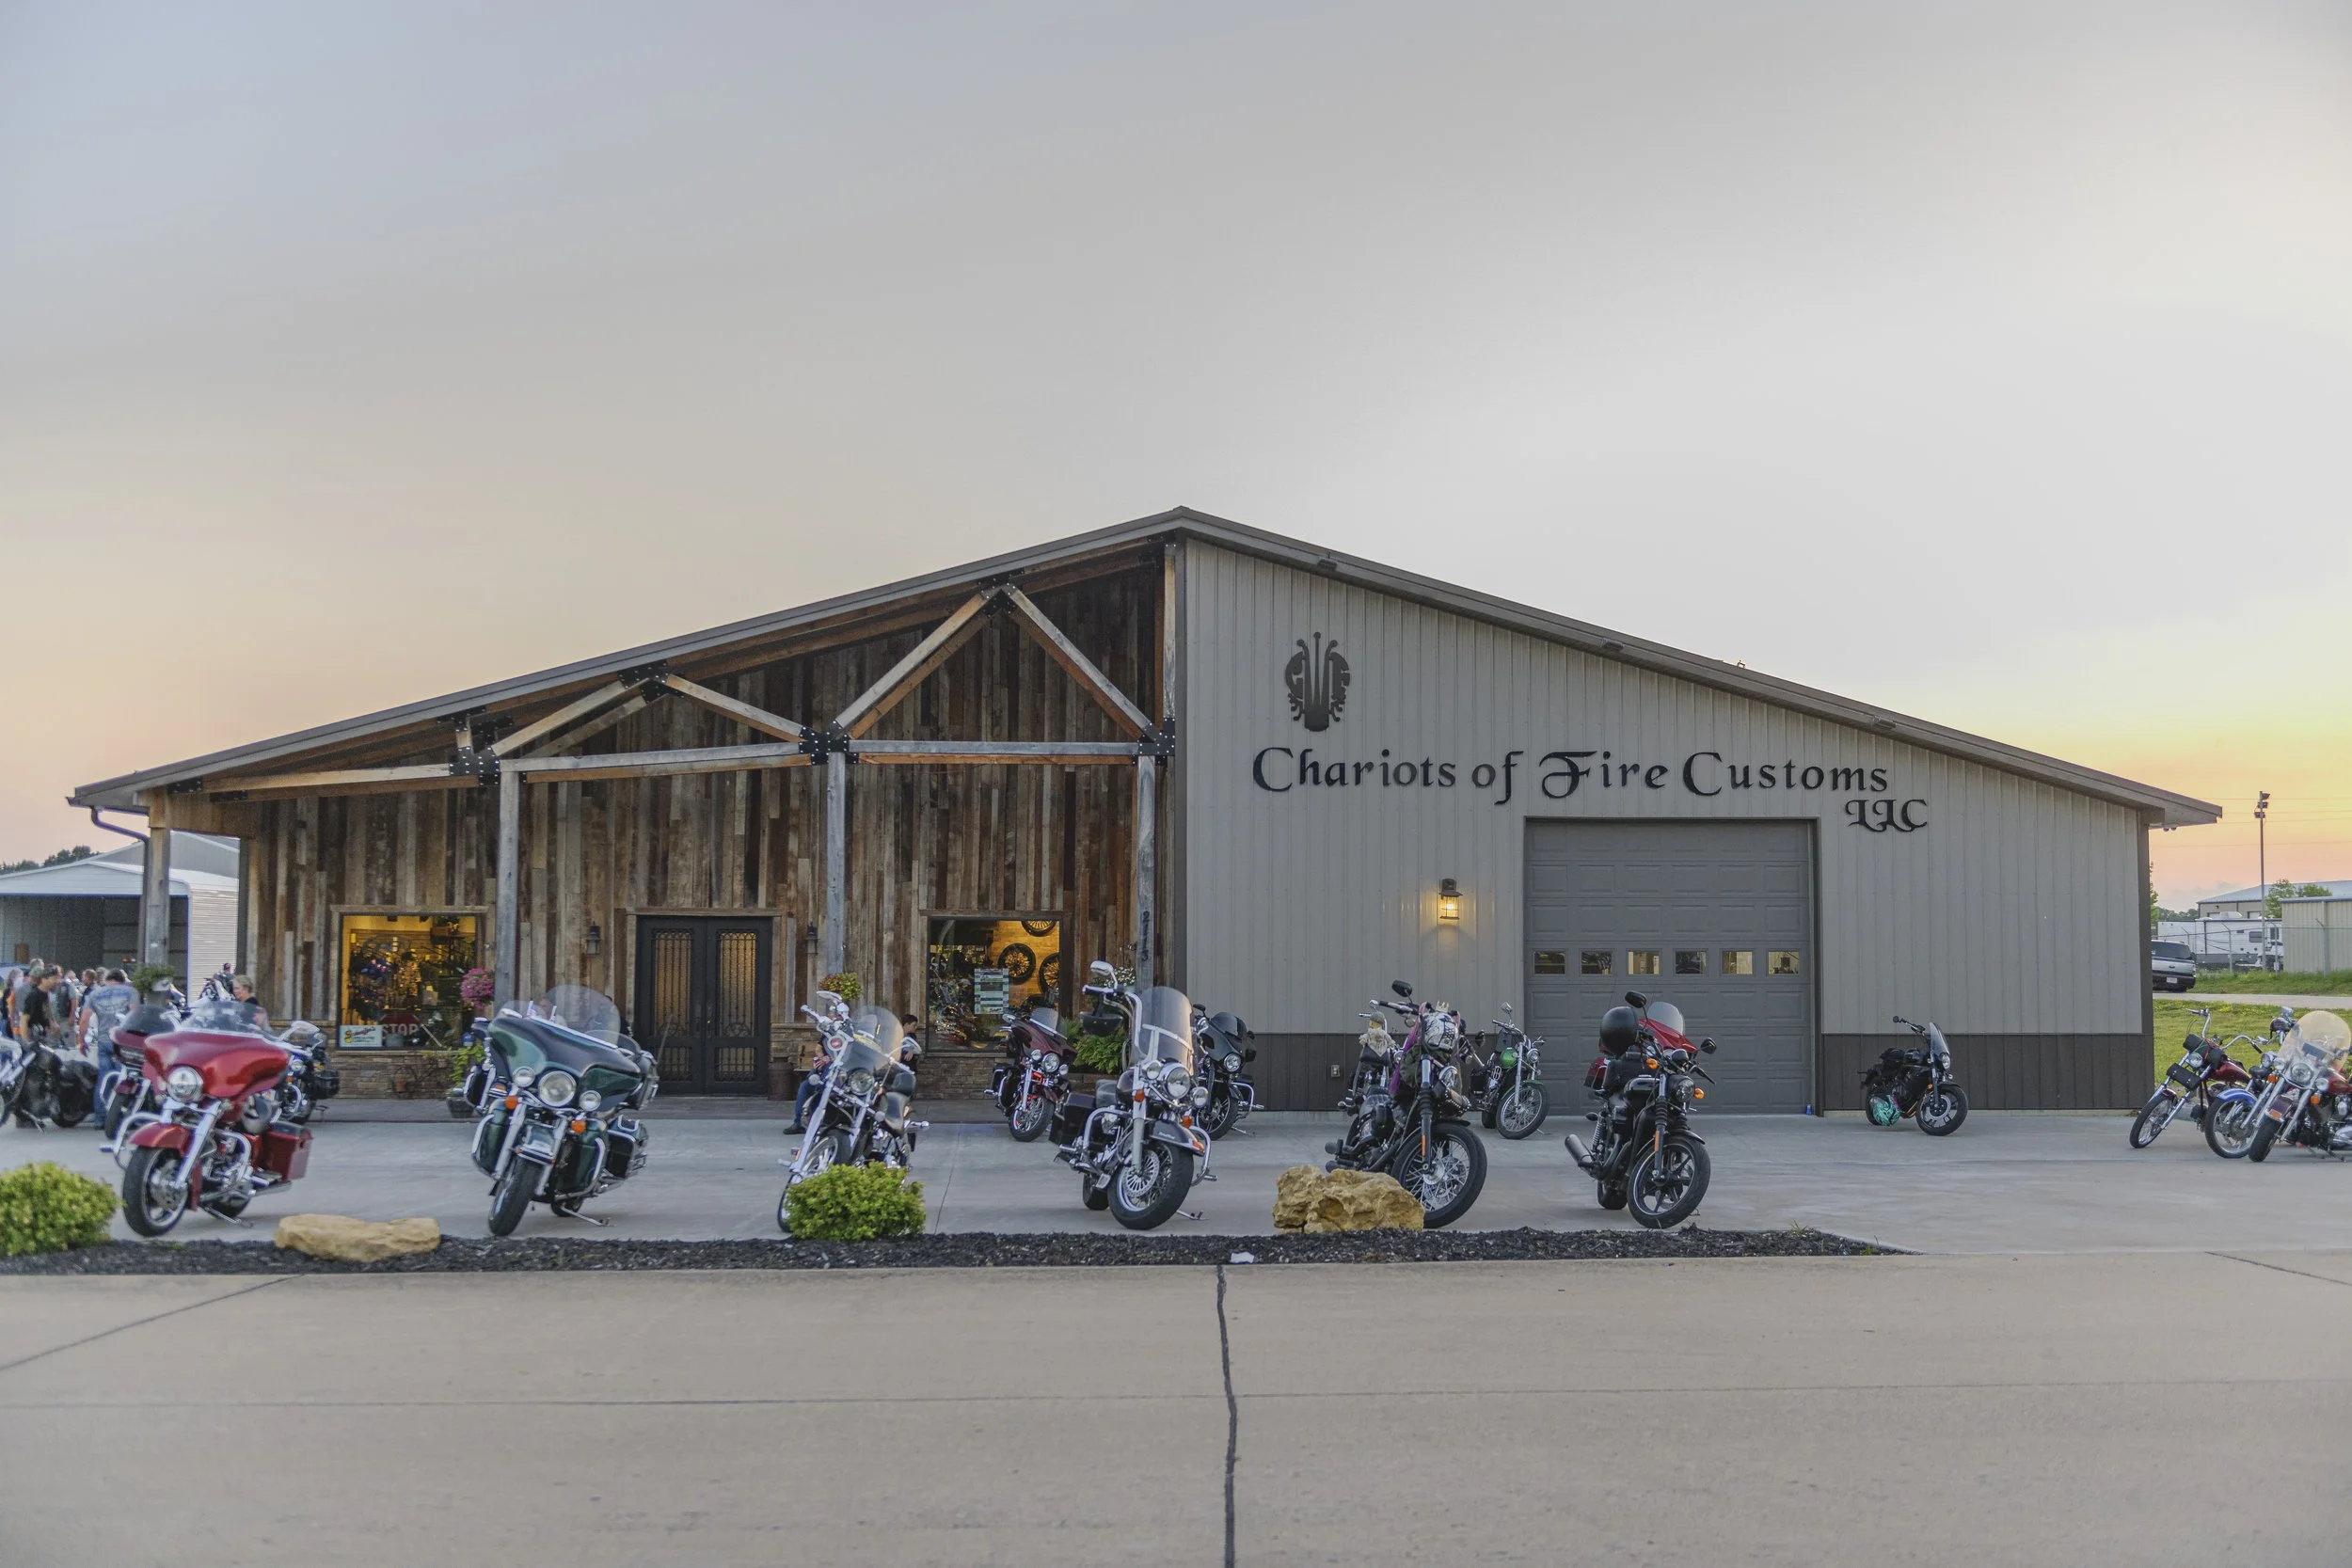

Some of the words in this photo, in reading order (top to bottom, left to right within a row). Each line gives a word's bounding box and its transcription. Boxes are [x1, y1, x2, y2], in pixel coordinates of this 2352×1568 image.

[1252, 746, 1457, 793] Chariots
[1470, 750, 1524, 806] of
[1537, 750, 1670, 800] Fire
[1682, 751, 1889, 797] Customs
[1844, 799, 1928, 833] LLC
